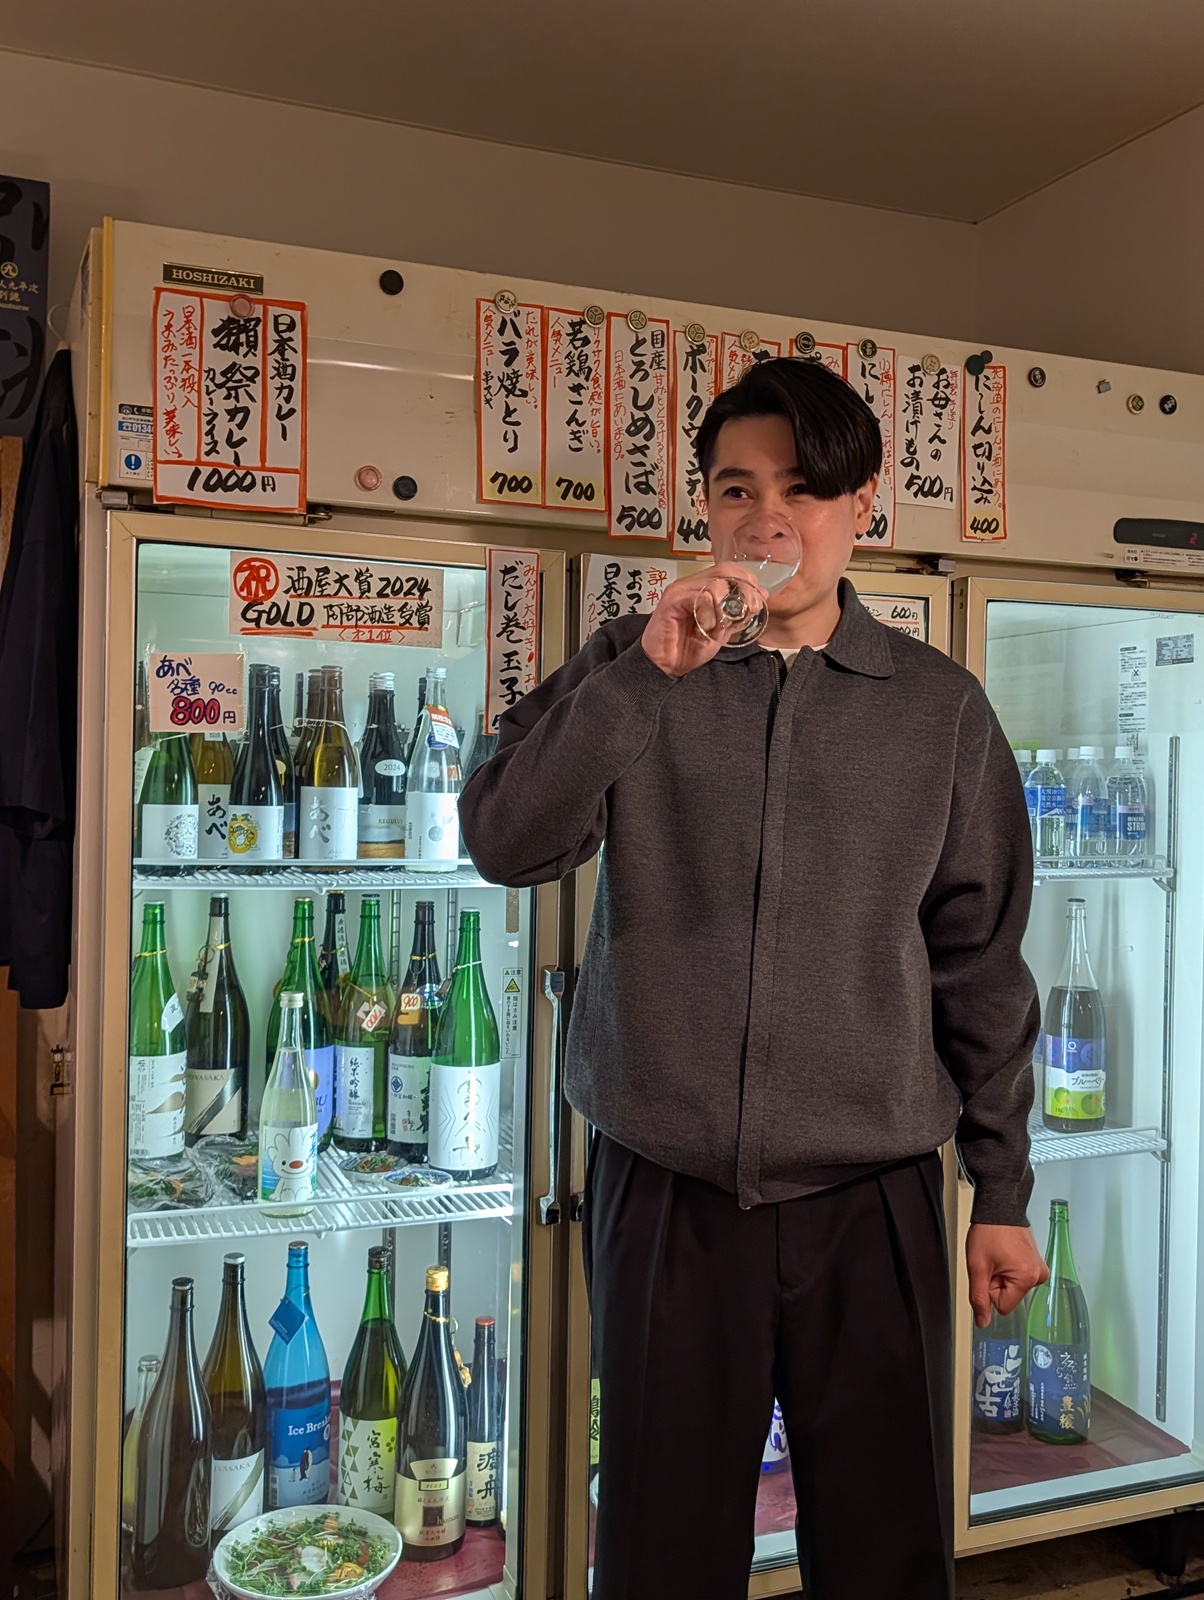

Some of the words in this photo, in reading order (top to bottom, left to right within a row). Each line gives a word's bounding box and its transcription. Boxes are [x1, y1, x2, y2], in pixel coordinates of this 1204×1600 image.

[171, 269, 256, 289] HOSHIZAKI
[482, 306, 496, 367] 人気メニュー
[549, 317, 564, 388] 人気メニュー
[649, 329, 667, 372] 国産
[267, 313, 298, 441] 日本酒カレー
[493, 309, 528, 453] バラ焼とり
[564, 317, 593, 453] 若鶏ざんぎ
[203, 366, 221, 457] カレーライス
[625, 332, 658, 496] とろしめさば
[900, 364, 926, 472] お漬けもの
[926, 368, 951, 462] お母さんの
[970, 374, 994, 505] にしん切り込み
[489, 471, 533, 494] 700
[556, 477, 595, 501] 700
[616, 504, 662, 532] 500
[969, 517, 1000, 535] 400
[238, 562, 273, 598] 祝
[241, 602, 316, 629] GOLD
[323, 600, 432, 631] 阿部酒造受賞
[496, 560, 526, 706] だし巻玉子
[155, 655, 193, 678] あべ
[167, 676, 201, 697] 各種
[208, 681, 237, 696] 90cc
[384, 763, 401, 771] 2024
[288, 1425, 305, 1436] Ice
[363, 1429, 390, 1494] 宮寒梅
